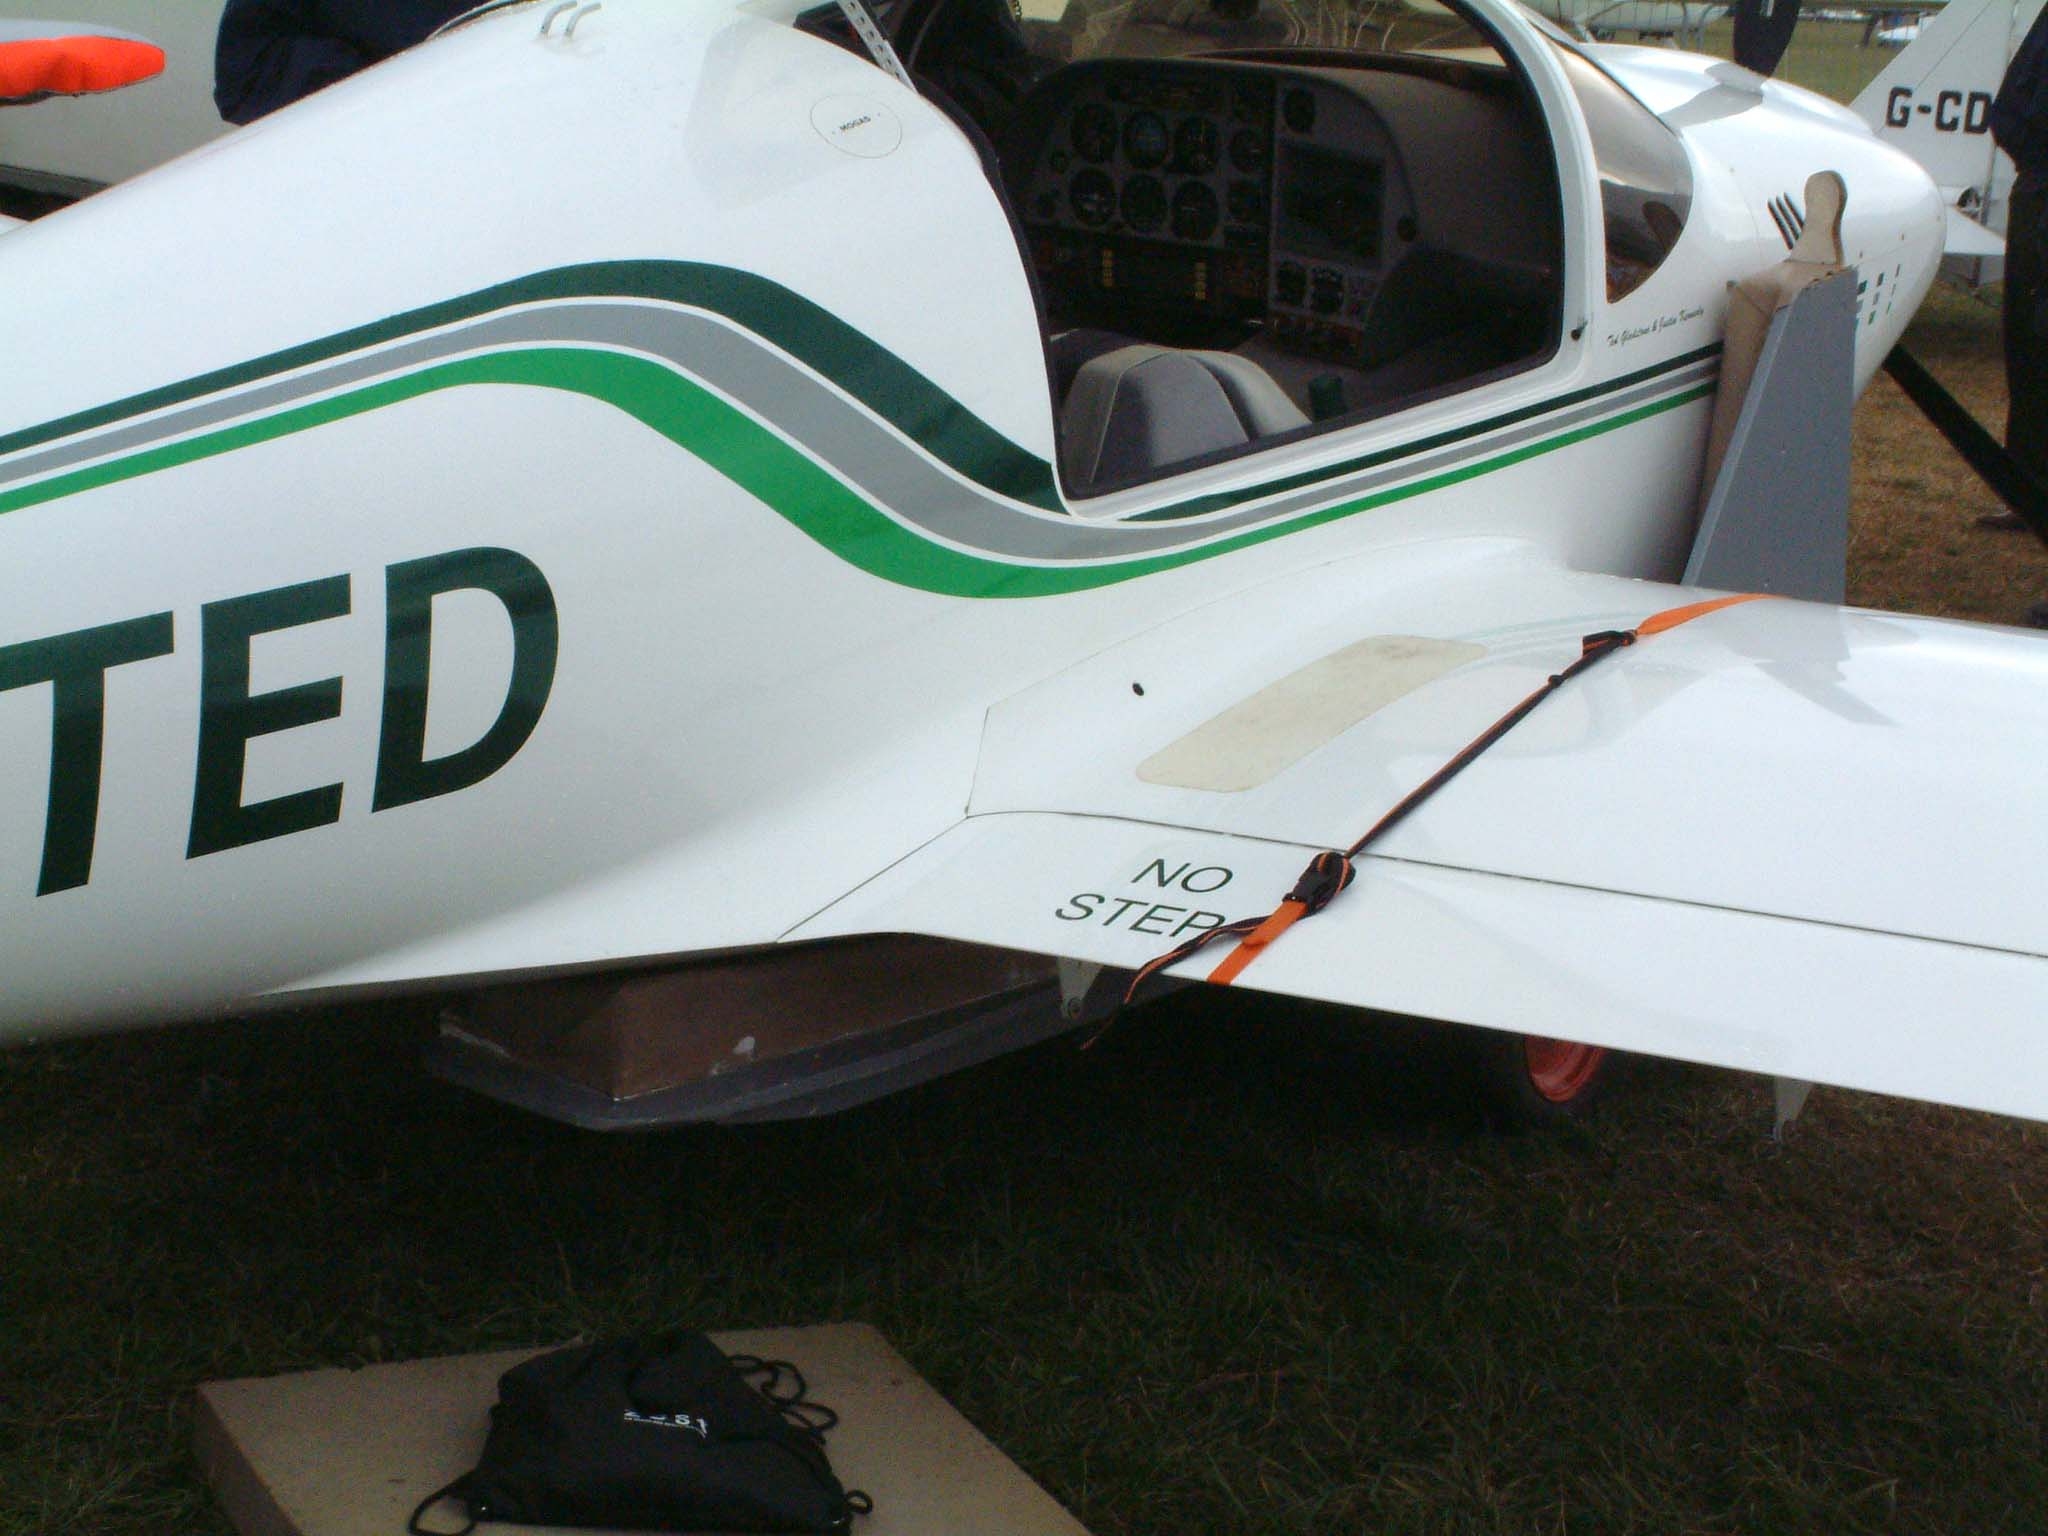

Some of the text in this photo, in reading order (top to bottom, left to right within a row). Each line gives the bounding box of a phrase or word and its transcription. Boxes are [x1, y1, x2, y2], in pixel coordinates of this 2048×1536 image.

[0, 546, 559, 897] TED
[1130, 858, 1233, 893] NO
[1055, 893, 1226, 937] STEP
